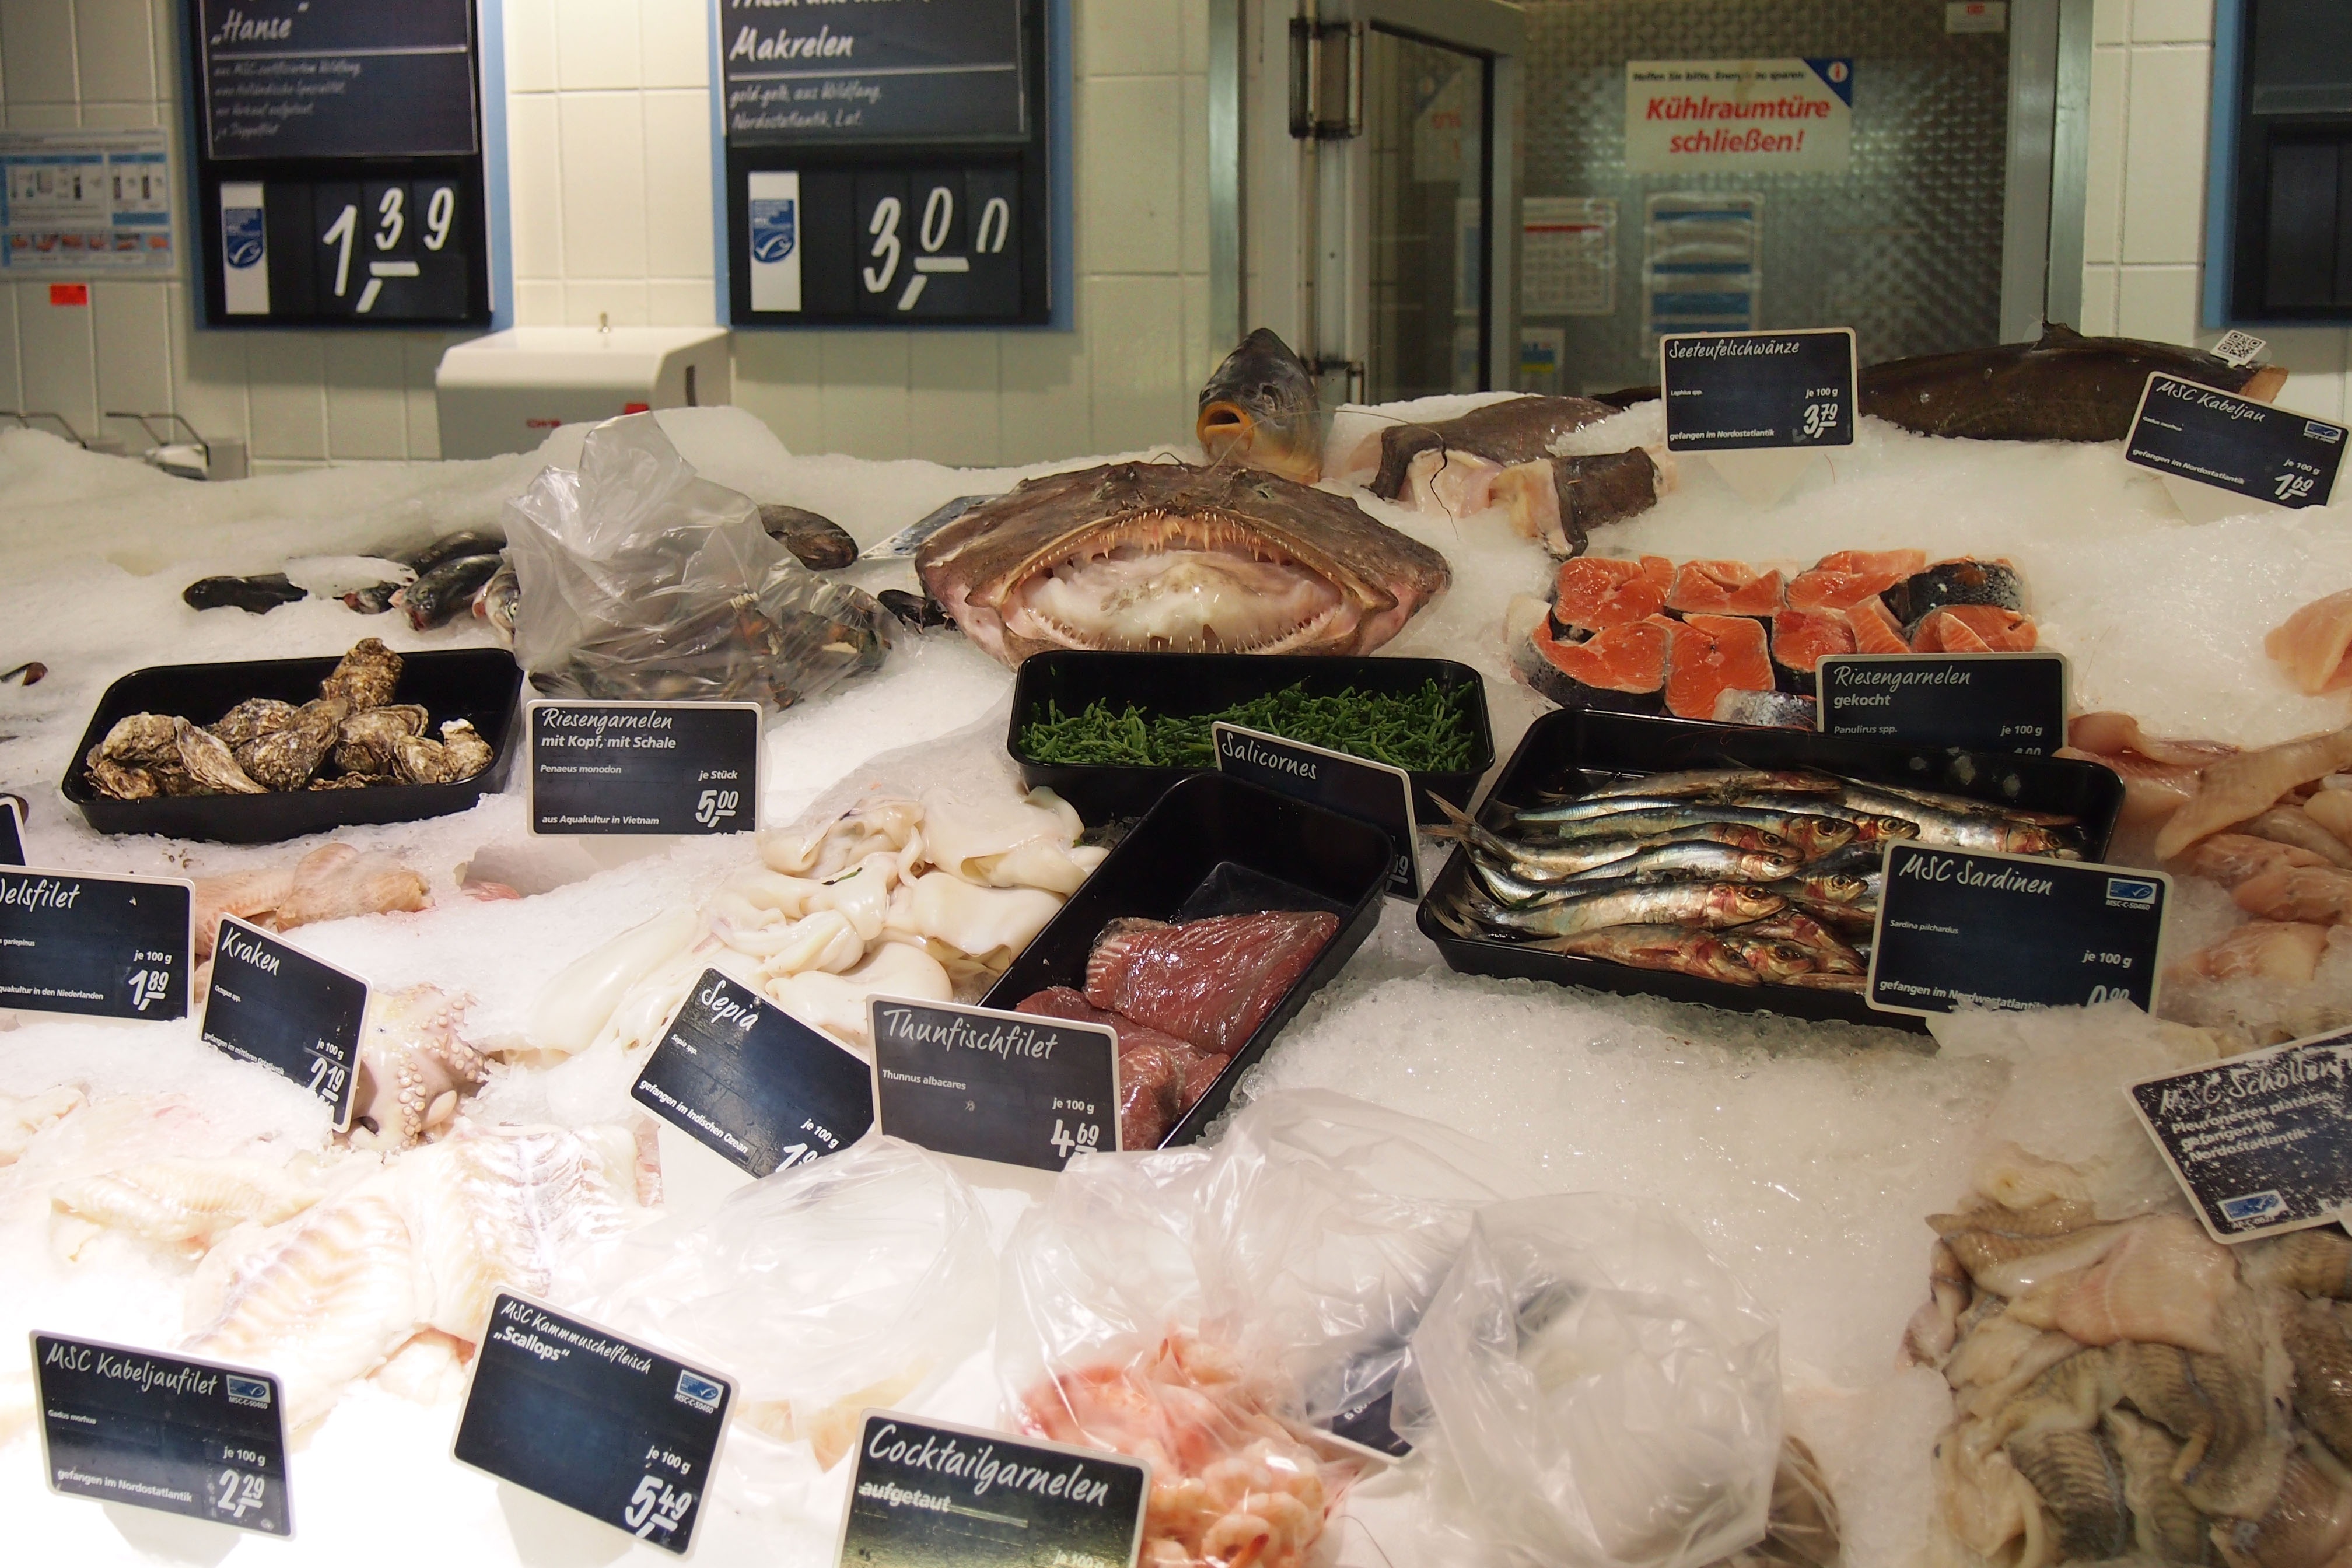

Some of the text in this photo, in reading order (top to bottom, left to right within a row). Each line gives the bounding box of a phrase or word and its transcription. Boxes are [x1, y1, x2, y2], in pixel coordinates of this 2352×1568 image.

[729, 24, 853, 62] Makrelen
[1646, 95, 1831, 121] Kühlraumtüre
[1669, 127, 1805, 154] schließen!
[1668, 338, 1800, 360] Seeteufelschwänze
[1805, 387, 1838, 399] je 100 g
[2156, 380, 2266, 423] MSC Kabeljau
[1670, 428, 1775, 442] gefangen im Nordostatlantik
[2132, 449, 2245, 485] gefangen im Nordostatlantik
[2283, 458, 2320, 476] je 100 g
[1834, 664, 1971, 692] Riesengarnelen
[1833, 693, 1891, 708] gekocht
[542, 708, 673, 734] Riesengarnelen
[1834, 725, 1898, 735] Panulirus spp.
[2000, 725, 2043, 737] je 100 g
[541, 735, 676, 750] mit Kopf, mit Schale
[1222, 732, 1318, 780] Salicornes
[540, 764, 622, 774] Penaeus monodon
[698, 769, 738, 782] je Stück
[559, 814, 610, 826] Aquakultur
[611, 815, 621, 824] in
[622, 816, 660, 825] Vietnam
[695, 789, 739, 828] 5,00
[1899, 853, 2053, 897] MSC Sardinen
[1889, 919, 1959, 935] Sardina pilchardus
[134, 949, 172, 964] je 100 g
[221, 926, 281, 977] Kraken
[2082, 949, 2133, 968] je 100 g
[33, 987, 40, 995] in
[42, 988, 55, 996] den
[57, 989, 104, 1000] Niederlanden
[1880, 979, 1930, 996] gefangen
[1932, 986, 1947, 998] im
[701, 979, 759, 1032] Sepia
[204, 1032, 228, 1048] gefangen
[228, 1042, 235, 1052] im
[671, 1033, 698, 1056] Sepia spp.
[883, 1009, 1058, 1060] Thunfischfilet
[316, 1038, 344, 1061] je 100 g
[883, 1069, 966, 1090] Thunnus albacares
[639, 1078, 749, 1154] gefangen im Indischen Ozean
[1052, 1097, 1094, 1115] je 100 g
[800, 1118, 839, 1149] je 100 g
[2180, 1125, 2253, 1150] gefangen
[501, 1300, 652, 1374] MSC Kammmuschelfleisch
[46, 1342, 218, 1396] MSC Kabeljaufilet
[48, 1409, 69, 1422] Gadus
[223, 1446, 266, 1466] je 100 g
[646, 1445, 691, 1475] je 100 g
[869, 1424, 1108, 1507] Cocktailgarnelen
[58, 1469, 192, 1503] gefangen im Nordostatlantik
[217, 1469, 265, 1518] 2,29
[862, 1481, 951, 1513] aufgetaut
[625, 1475, 692, 1538] 5,49
